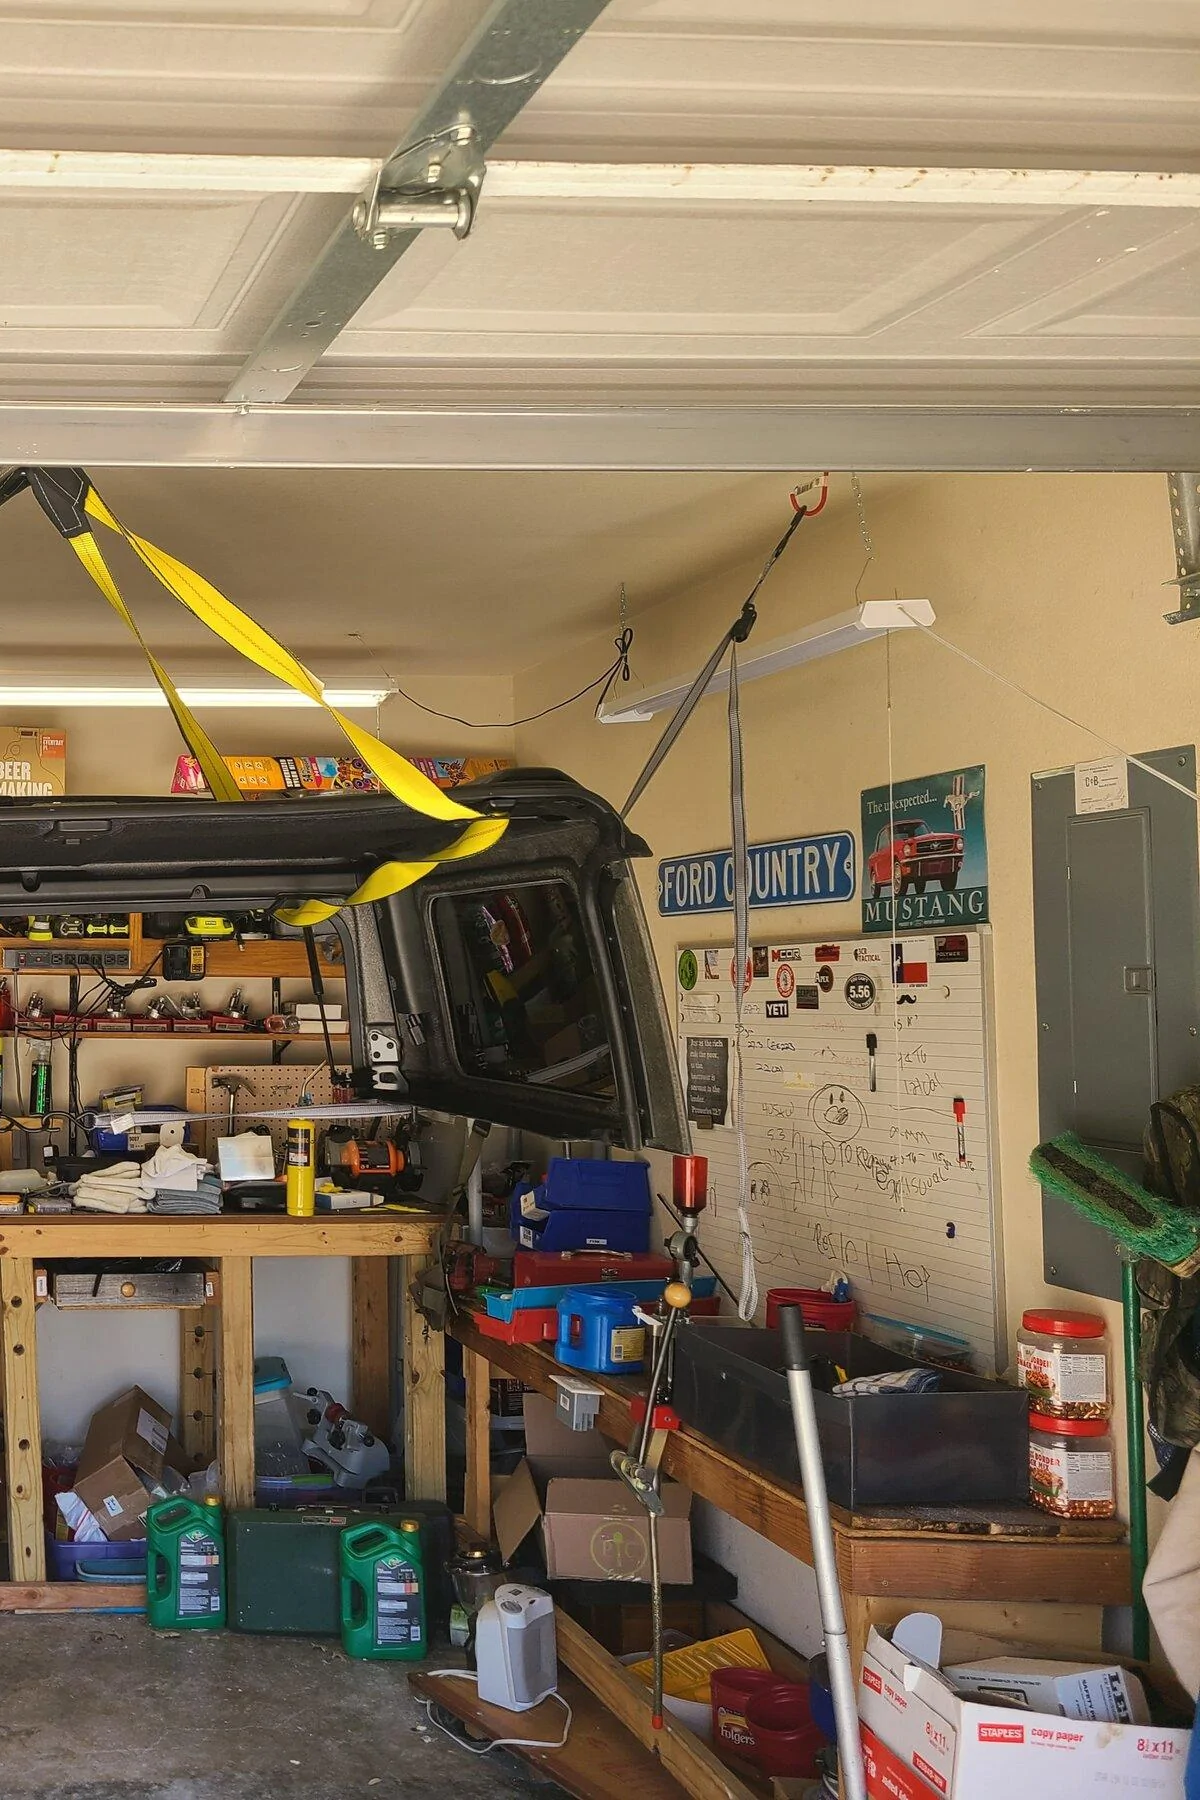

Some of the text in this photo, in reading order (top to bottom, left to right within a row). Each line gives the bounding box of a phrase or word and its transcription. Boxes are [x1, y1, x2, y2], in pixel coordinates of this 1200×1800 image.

[866, 800, 884, 815] The
[664, 860, 717, 908] FORD
[864, 890, 985, 923] MUSTANG
[849, 985, 871, 999] 5.56
[767, 1003, 788, 1017] YETI
[1035, 1453, 1061, 1467] BORDER
[721, 1724, 755, 1745] Folgers
[980, 1727, 1022, 1738] STAPLES
[1031, 1728, 1084, 1743] copy paper
